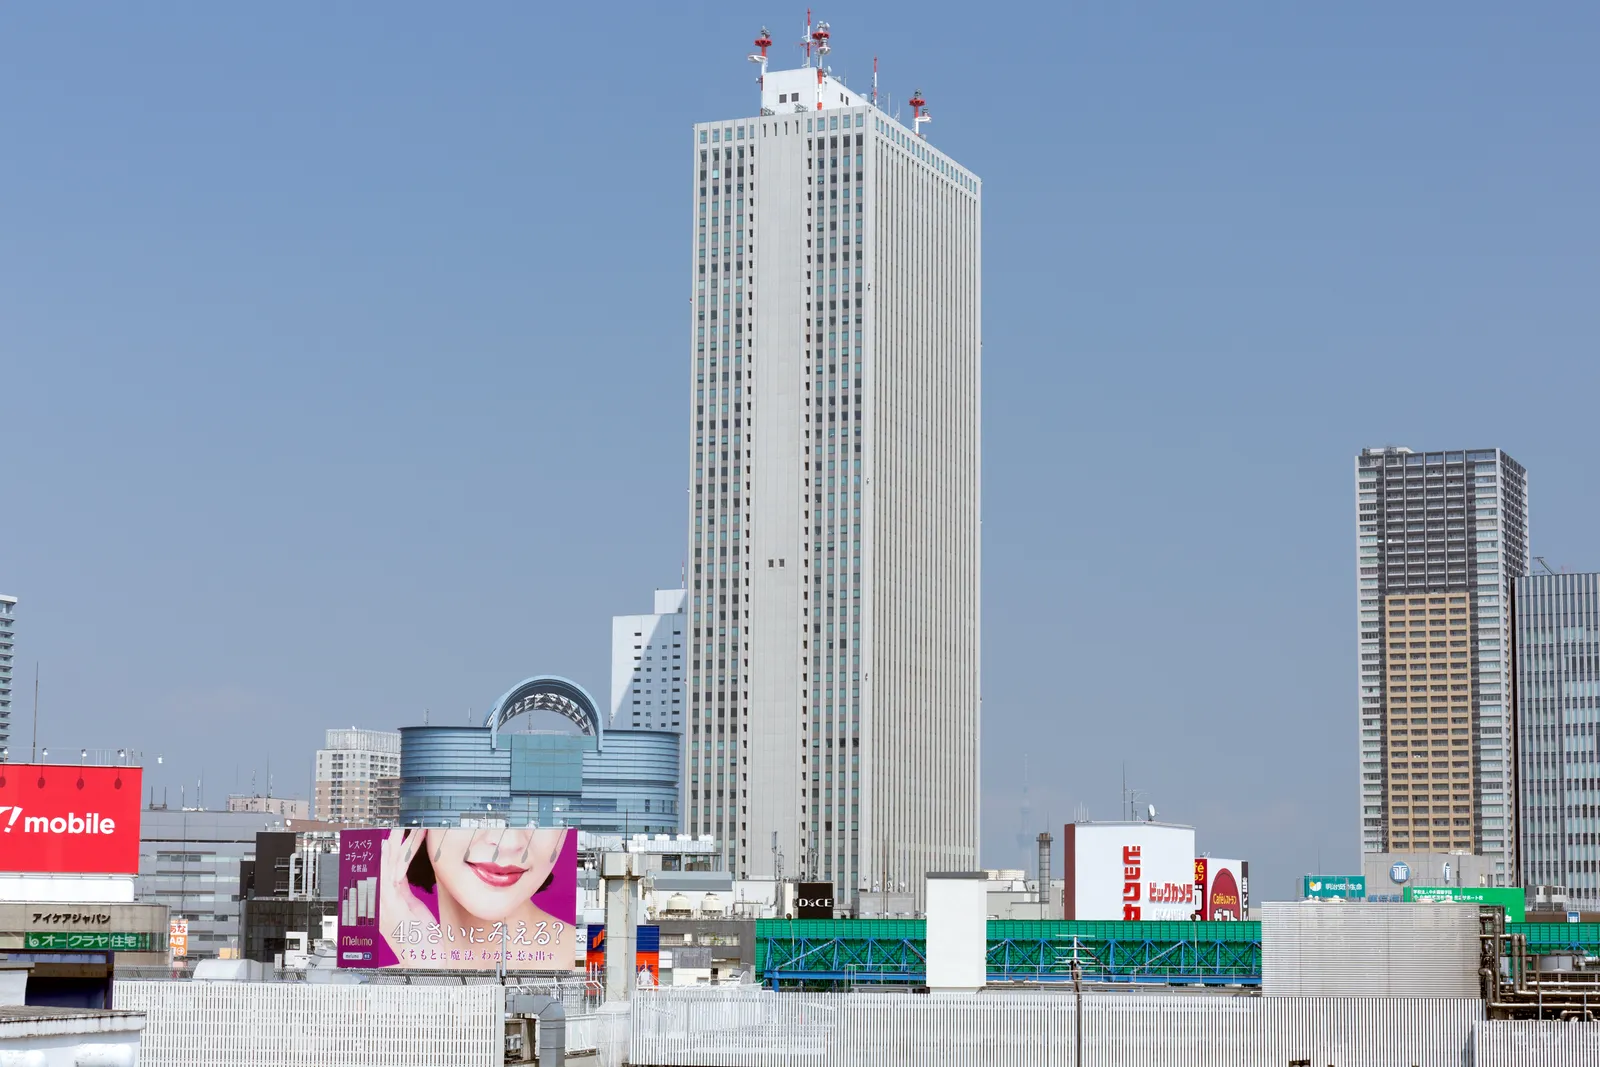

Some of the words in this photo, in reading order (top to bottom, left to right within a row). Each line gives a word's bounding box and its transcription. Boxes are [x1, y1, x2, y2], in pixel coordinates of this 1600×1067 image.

[24, 812, 115, 834] mobile
[345, 851, 375, 862] コラーゲン
[1149, 882, 1193, 903] ビックカメラ
[32, 913, 111, 925] アイケアジャパン
[42, 934, 137, 948] オークラヤ住宅
